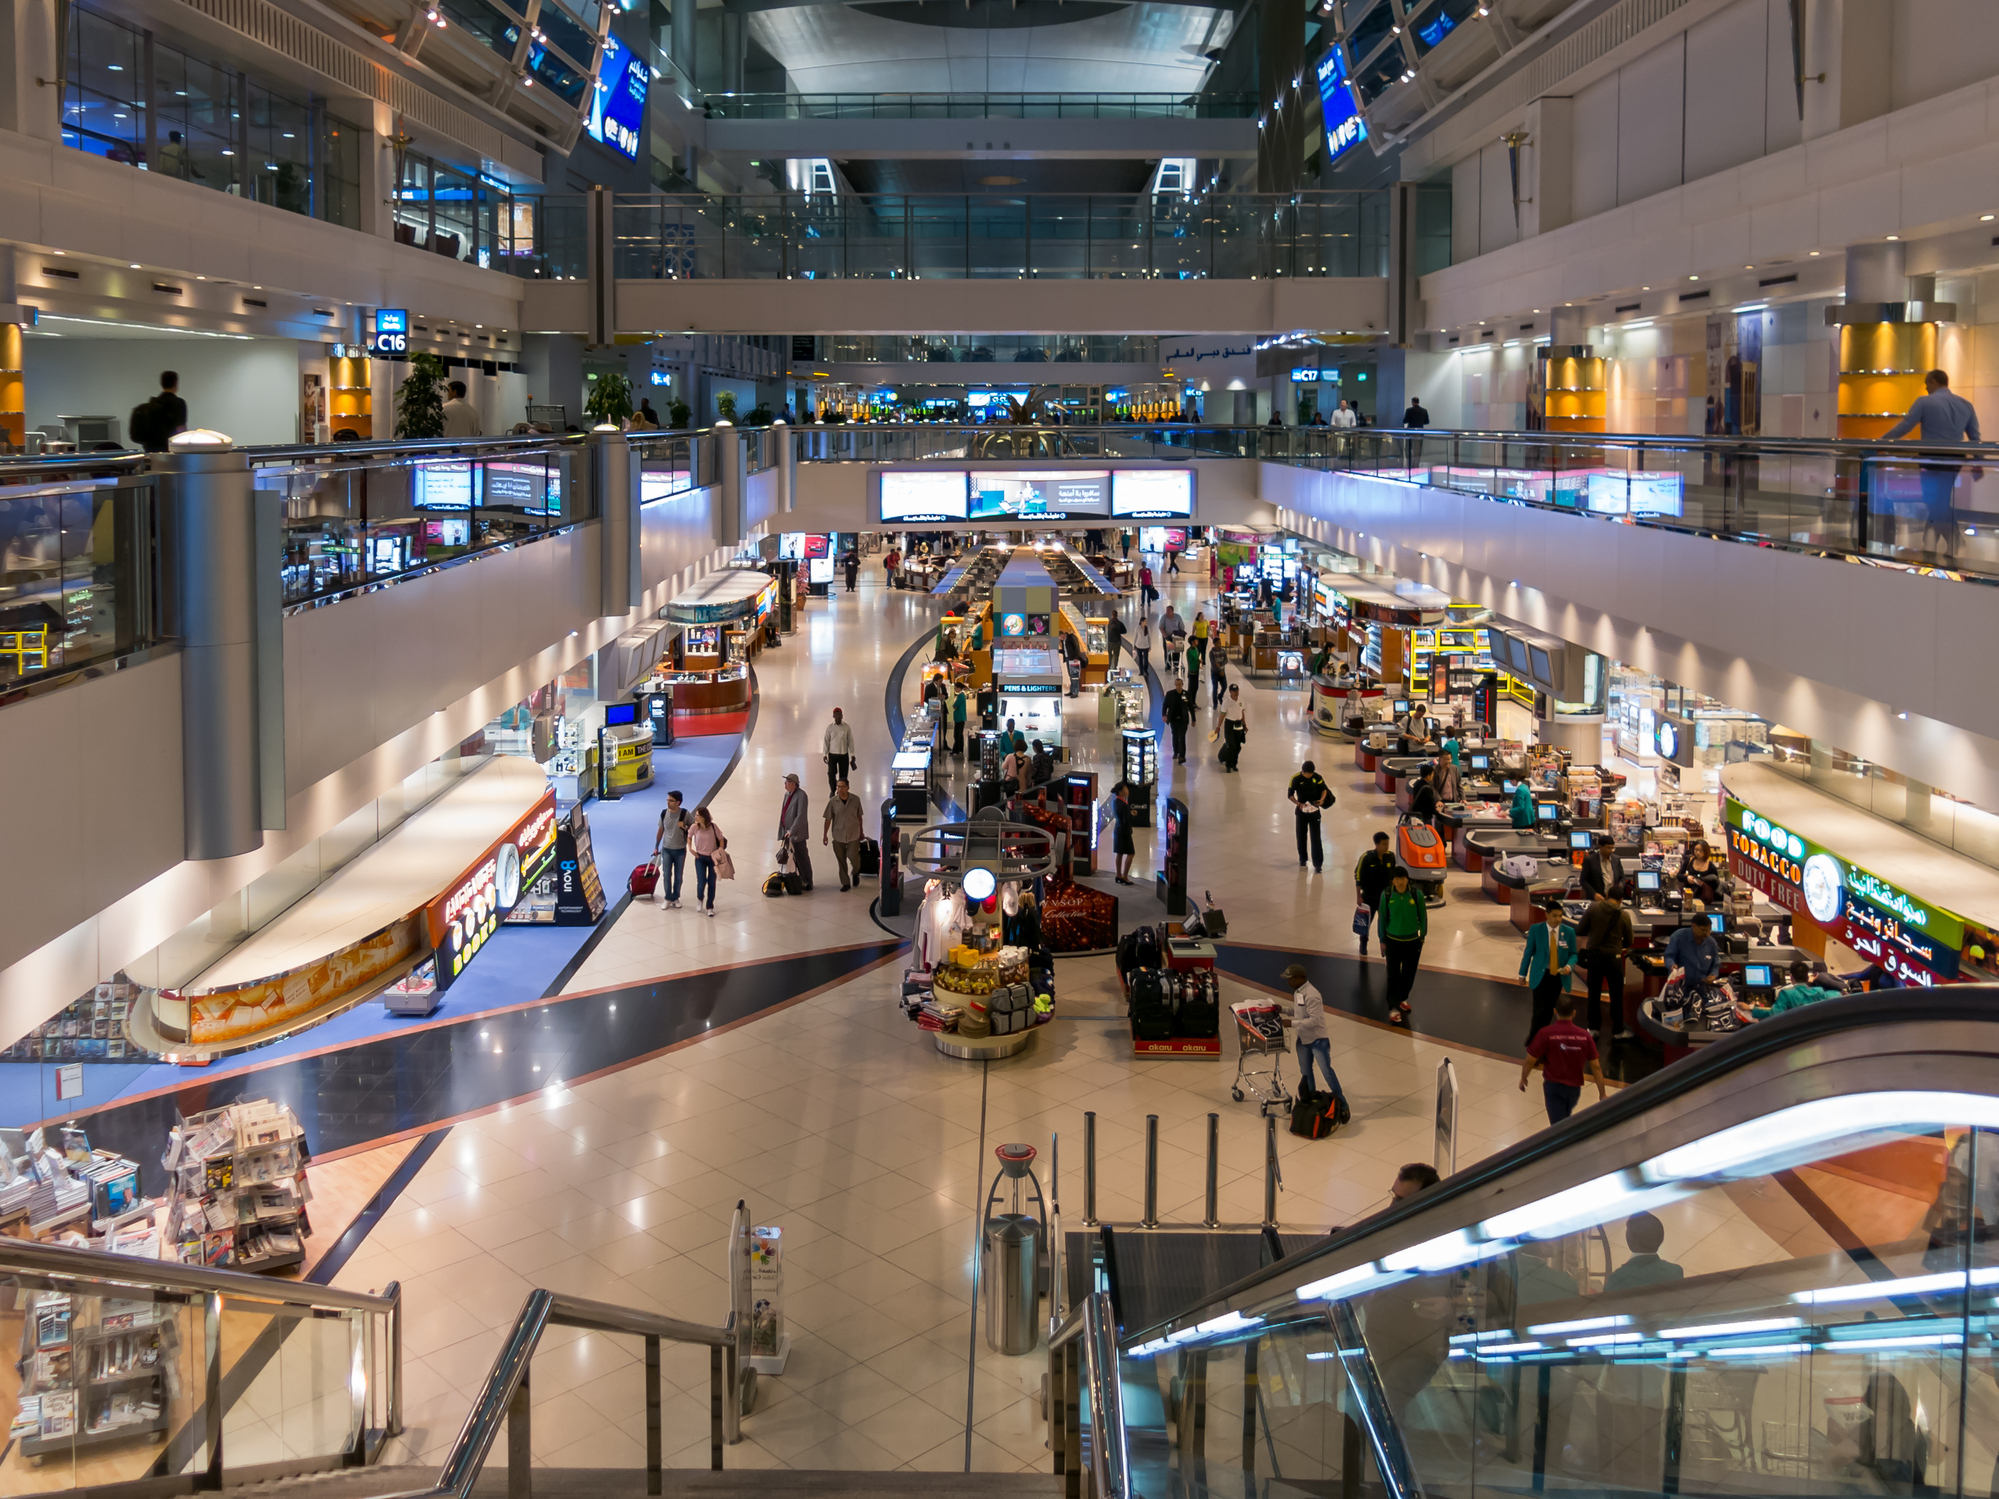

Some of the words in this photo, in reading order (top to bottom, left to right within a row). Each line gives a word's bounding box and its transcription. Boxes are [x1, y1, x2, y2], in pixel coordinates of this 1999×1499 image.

[377, 334, 406, 351] C16
[1301, 369, 1318, 381] C17
[1742, 809, 1805, 859] FOOD
[1731, 829, 1801, 885] TOBACCO
[1738, 858, 1765, 889] DUTY
[1770, 878, 1800, 912] FREE
[453, 913, 497, 976] BOOKS
[1845, 925, 1882, 957] الحرة
[1882, 917, 1933, 960] سجائر
[1884, 948, 1932, 988] السوق
[1148, 1043, 1173, 1051] akaru
[1182, 1043, 1207, 1052] akaru
